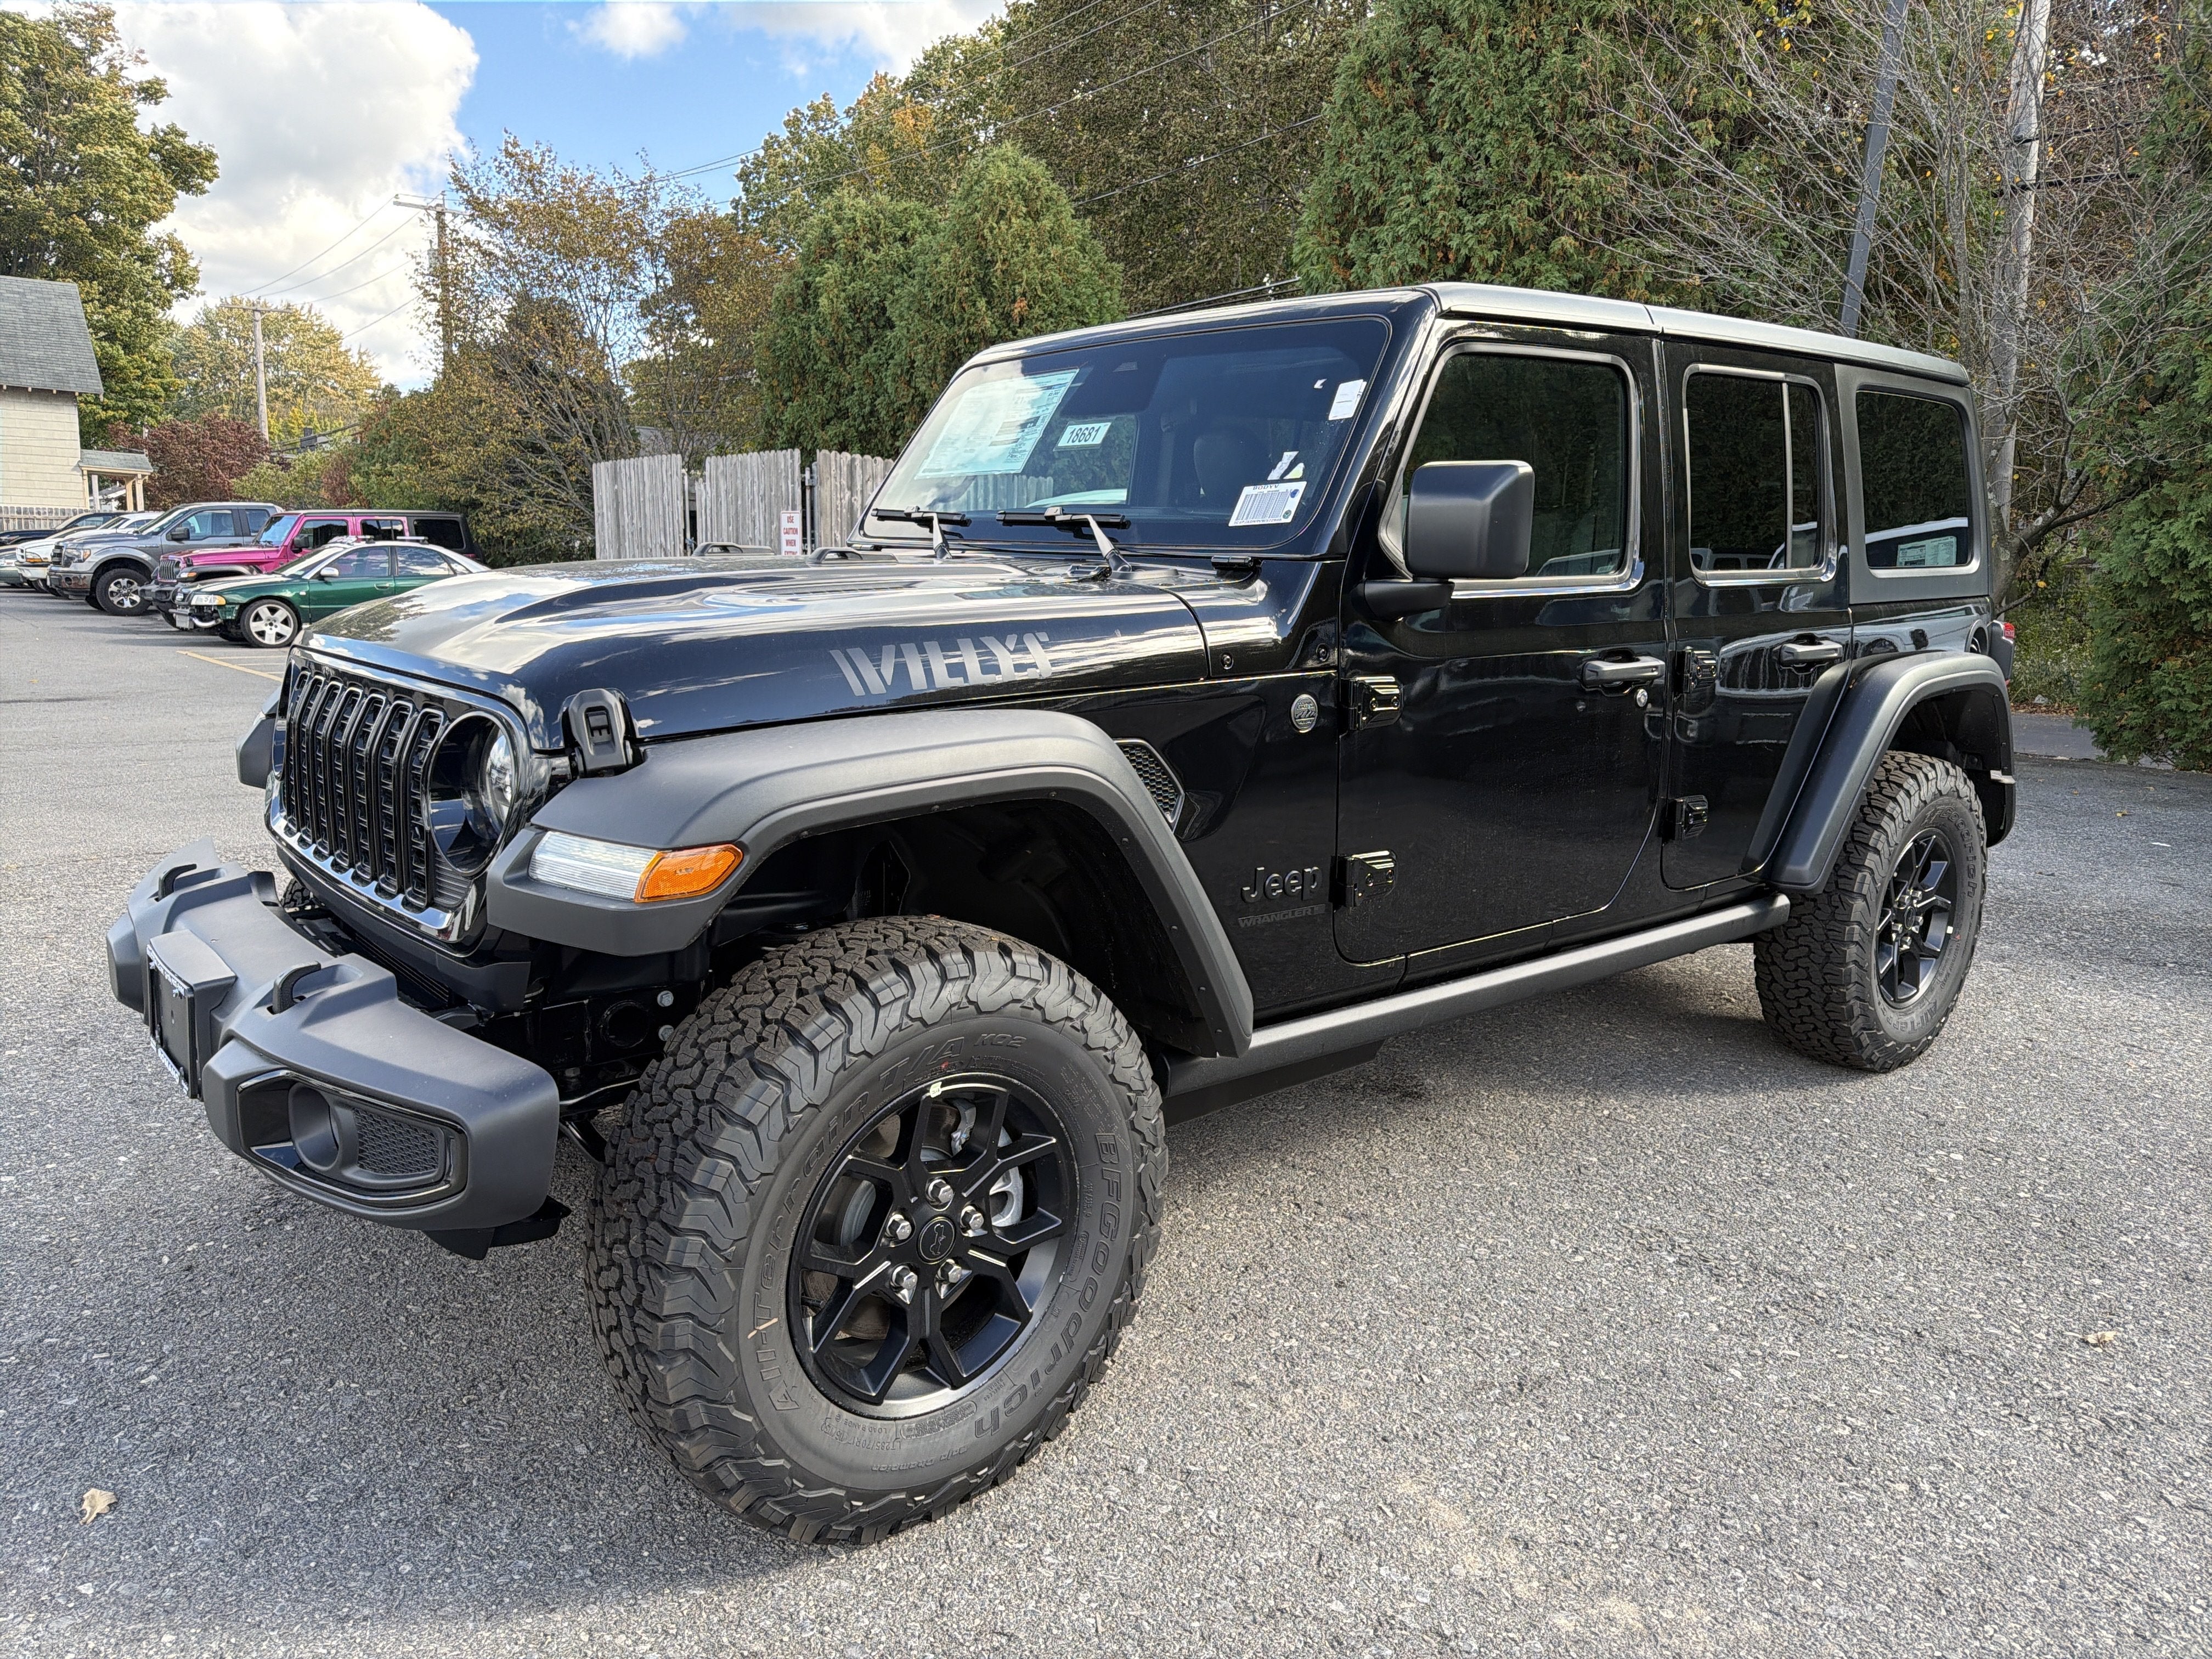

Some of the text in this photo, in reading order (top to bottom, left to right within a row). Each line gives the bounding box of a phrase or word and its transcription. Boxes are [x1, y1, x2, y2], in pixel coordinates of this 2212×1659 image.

[1066, 426, 1102, 443] 18681
[830, 632, 1052, 696] WILLYS
[1241, 866, 1322, 903] Jeep
[1238, 907, 1312, 928] WRANGLER
[753, 1092, 870, 1410] All-Terrain
[878, 1036, 964, 1092] T/A
[974, 1033, 1027, 1048] KO2
[974, 1133, 1122, 1438] BFGoodrich
[843, 1419, 867, 1432] RANGE
[868, 1426, 888, 1435] LOAD
